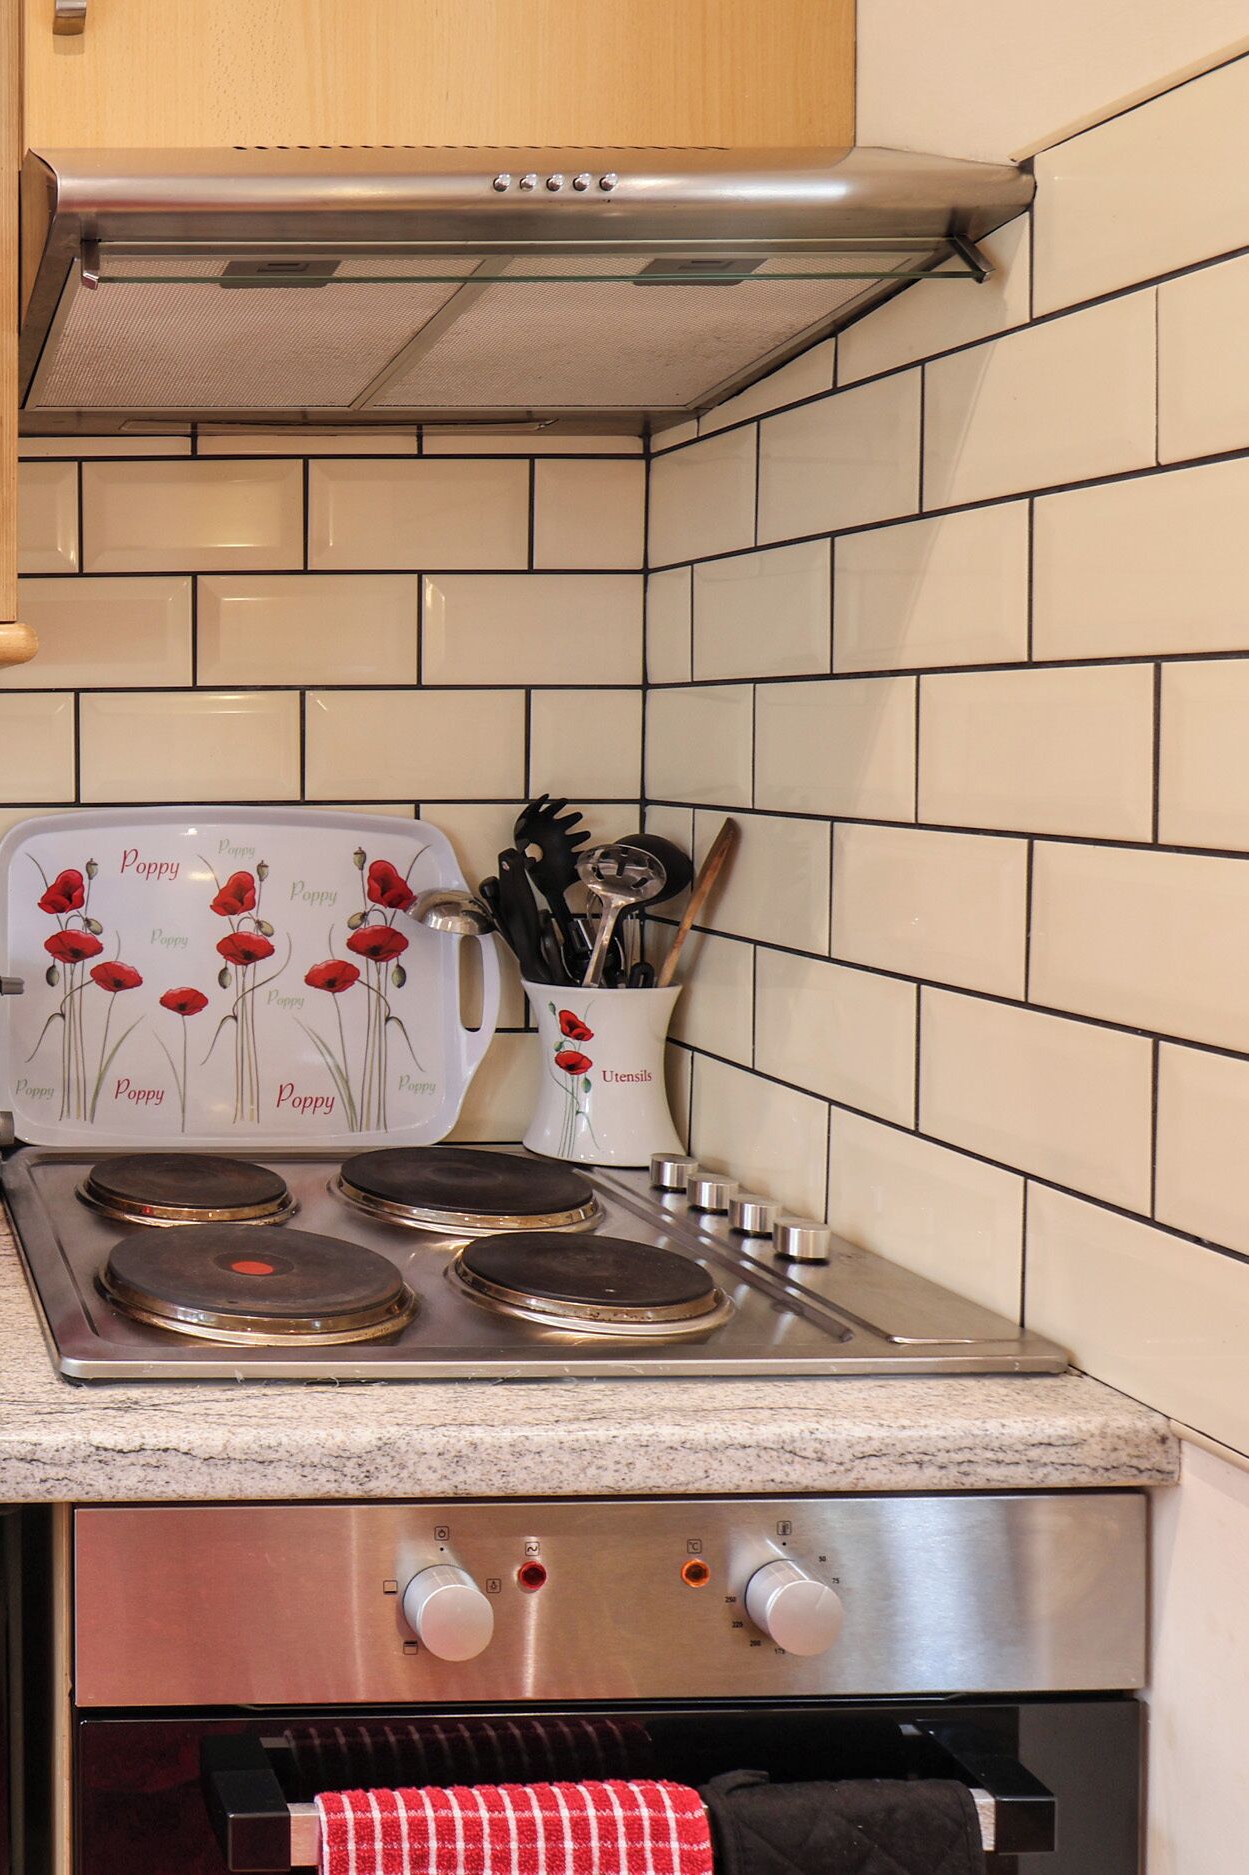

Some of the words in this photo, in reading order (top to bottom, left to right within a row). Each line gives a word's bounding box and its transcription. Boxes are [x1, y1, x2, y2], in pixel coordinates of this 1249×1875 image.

[217, 838, 256, 860] Poppy
[120, 848, 180, 881] Poppy
[290, 880, 337, 906] Poppy
[150, 928, 189, 947] Poppy
[266, 989, 305, 1009] Poppy
[398, 1074, 437, 1096] Poppy
[601, 1069, 653, 1083] Utensils
[15, 1079, 55, 1100] Poppy
[114, 1078, 164, 1106] Poppy
[276, 1082, 336, 1115] Poppy
